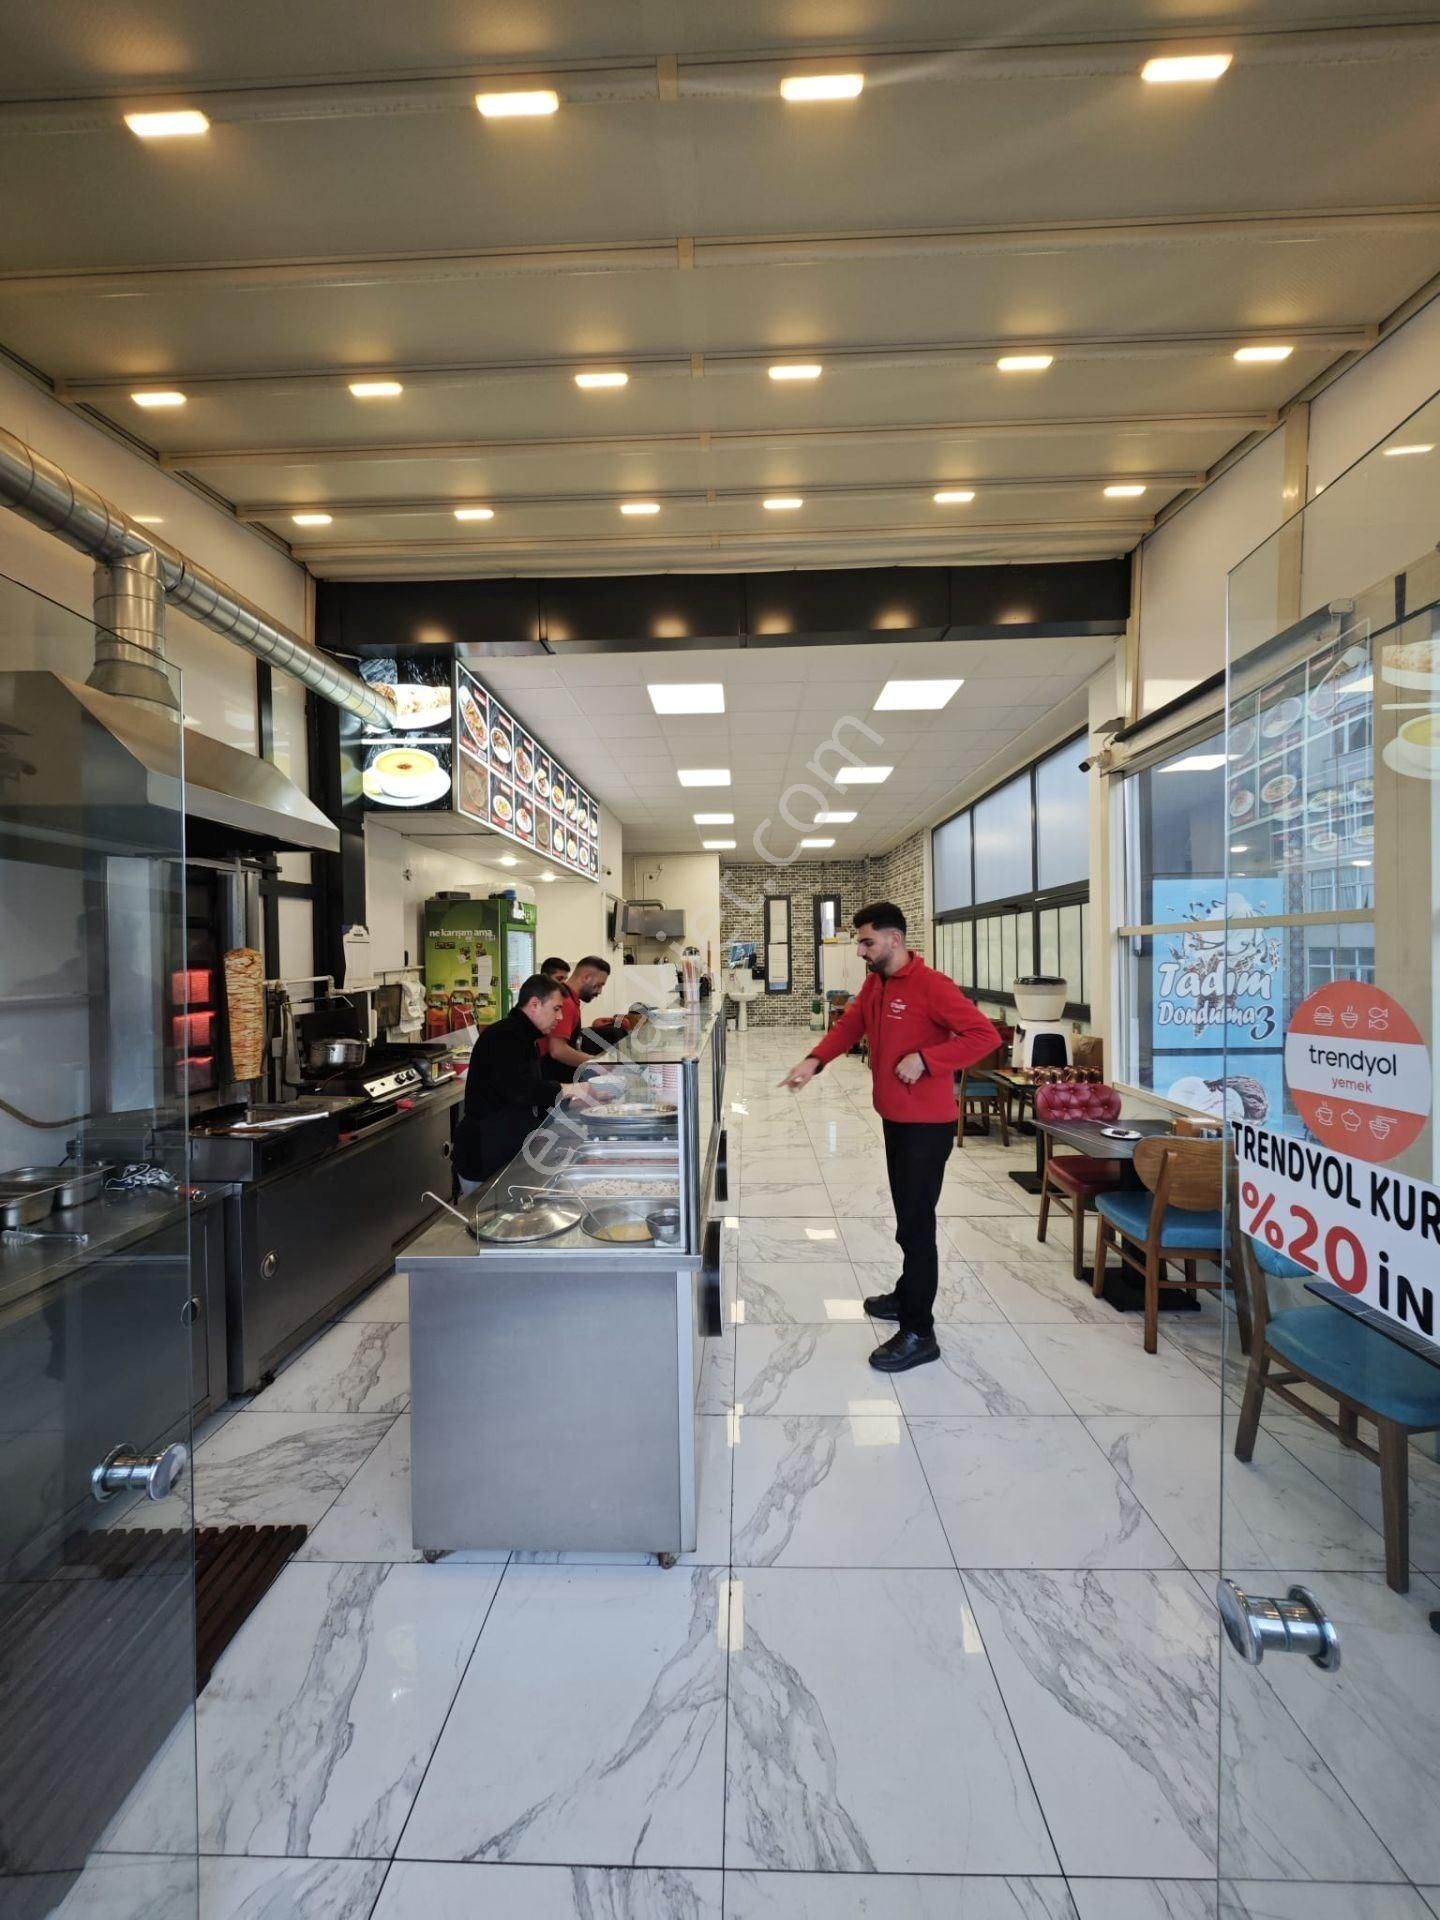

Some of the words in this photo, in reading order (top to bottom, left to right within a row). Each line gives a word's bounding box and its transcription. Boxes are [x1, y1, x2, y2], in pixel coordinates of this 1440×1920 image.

[1158, 959, 1272, 1000] Tadım
[1308, 1044, 1397, 1077] trendyol
[1331, 1075, 1372, 1094] yemek
[1231, 1120, 1361, 1209] TRENDYOL
[1241, 1180, 1368, 1295] %20
